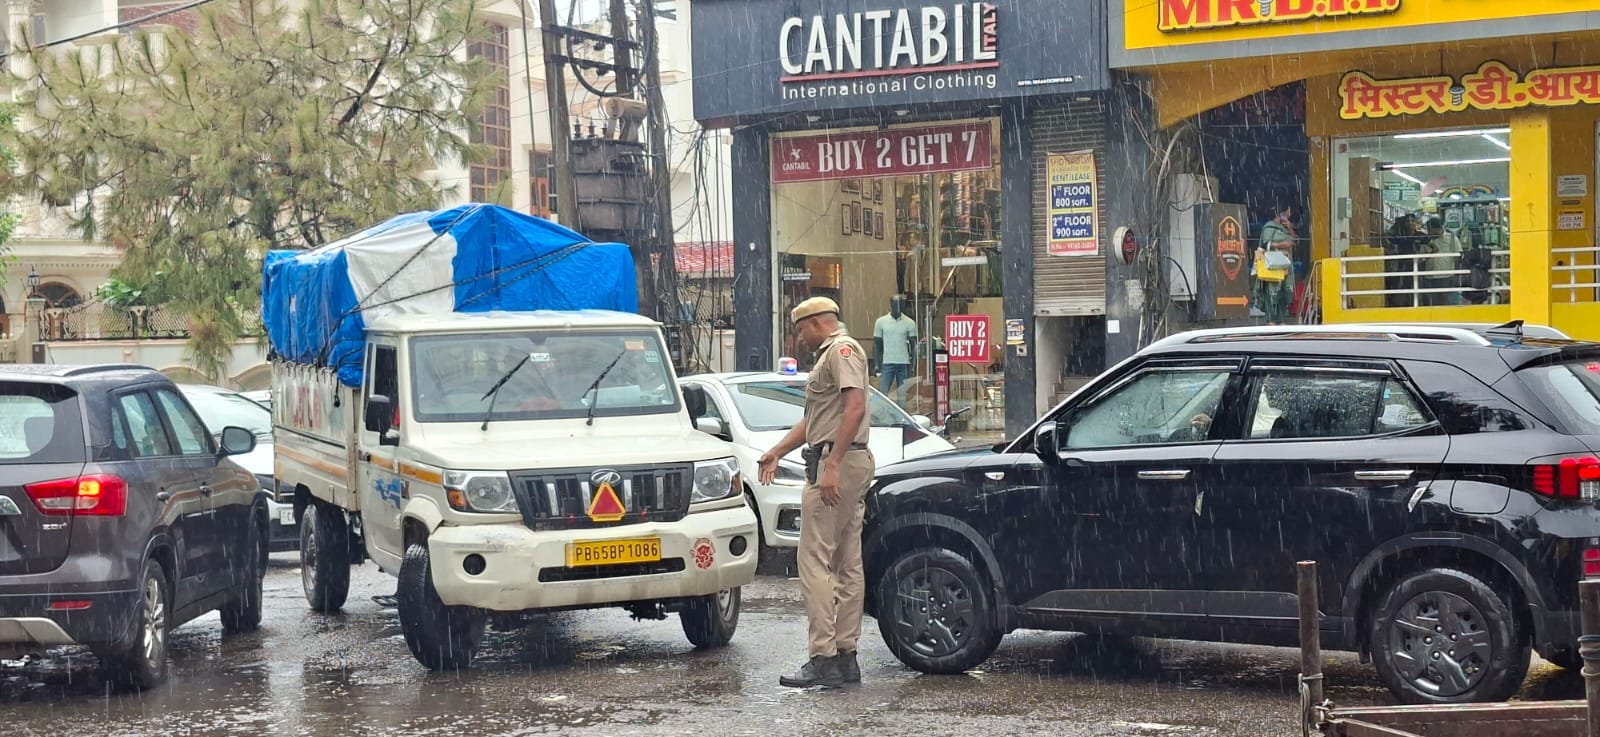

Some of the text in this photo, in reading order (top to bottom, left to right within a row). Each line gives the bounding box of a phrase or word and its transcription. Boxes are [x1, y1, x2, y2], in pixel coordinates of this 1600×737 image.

[983, 2, 997, 51] ITALY
[779, 2, 996, 75] CANTABIL
[782, 77, 907, 100] International
[913, 73, 996, 90] Clothing
[1343, 76, 1450, 115] मिस्टर
[818, 130, 977, 173] BUY 2 GET 7
[782, 161, 811, 171] CANTABIL
[1063, 185, 1090, 196] FLOOR
[1055, 198, 1070, 207] 800
[1064, 216, 1091, 226] FLOOR
[1056, 228, 1071, 237] 900
[950, 320, 975, 338] BUY
[977, 320, 986, 338] 2
[950, 339, 986, 357] GET 7
[576, 543, 658, 561] PB65BP1086
